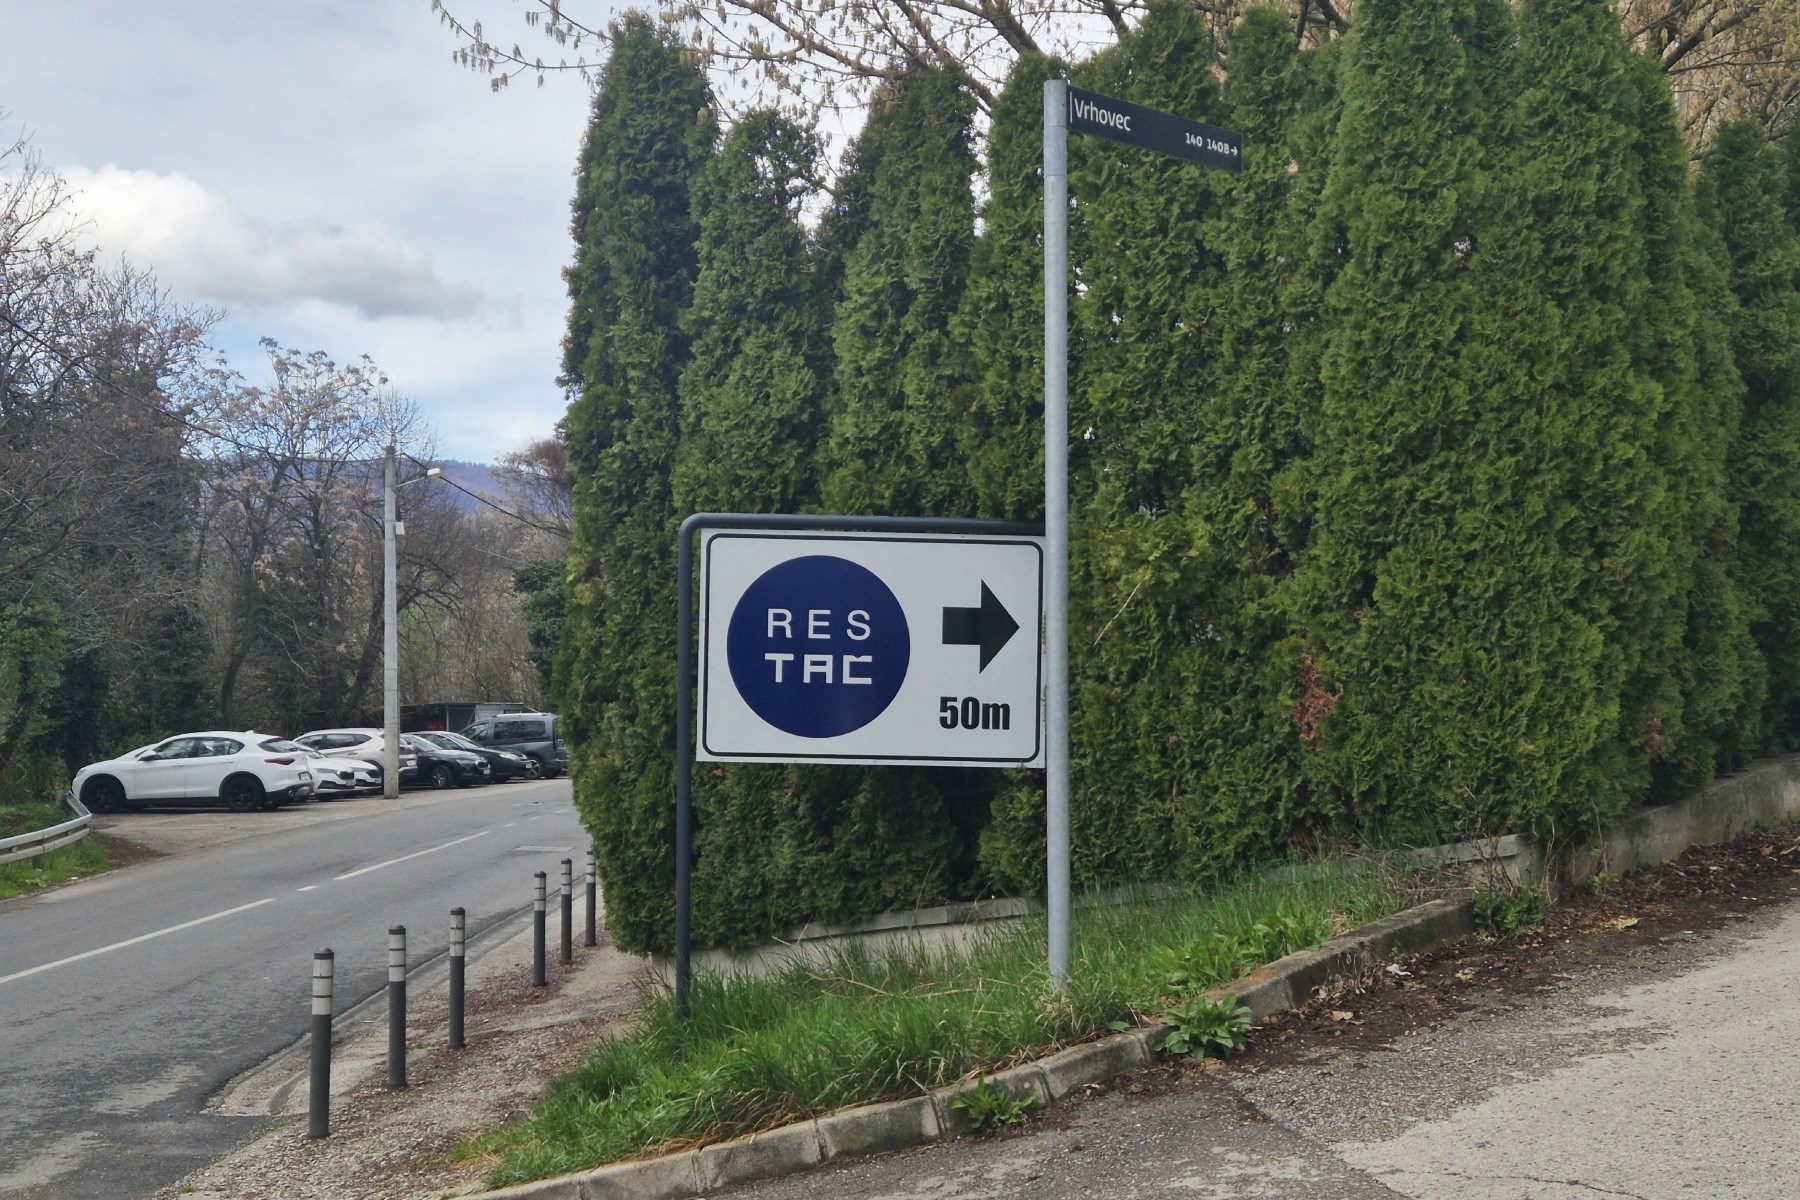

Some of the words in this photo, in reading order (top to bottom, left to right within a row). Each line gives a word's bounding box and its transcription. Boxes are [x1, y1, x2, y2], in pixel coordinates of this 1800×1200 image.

[1074, 97, 1131, 132] Vrhovec
[1185, 132, 1203, 147] 140
[1206, 138, 1230, 155] 140B
[767, 608, 871, 641] RES
[939, 696, 1011, 730] 50m
